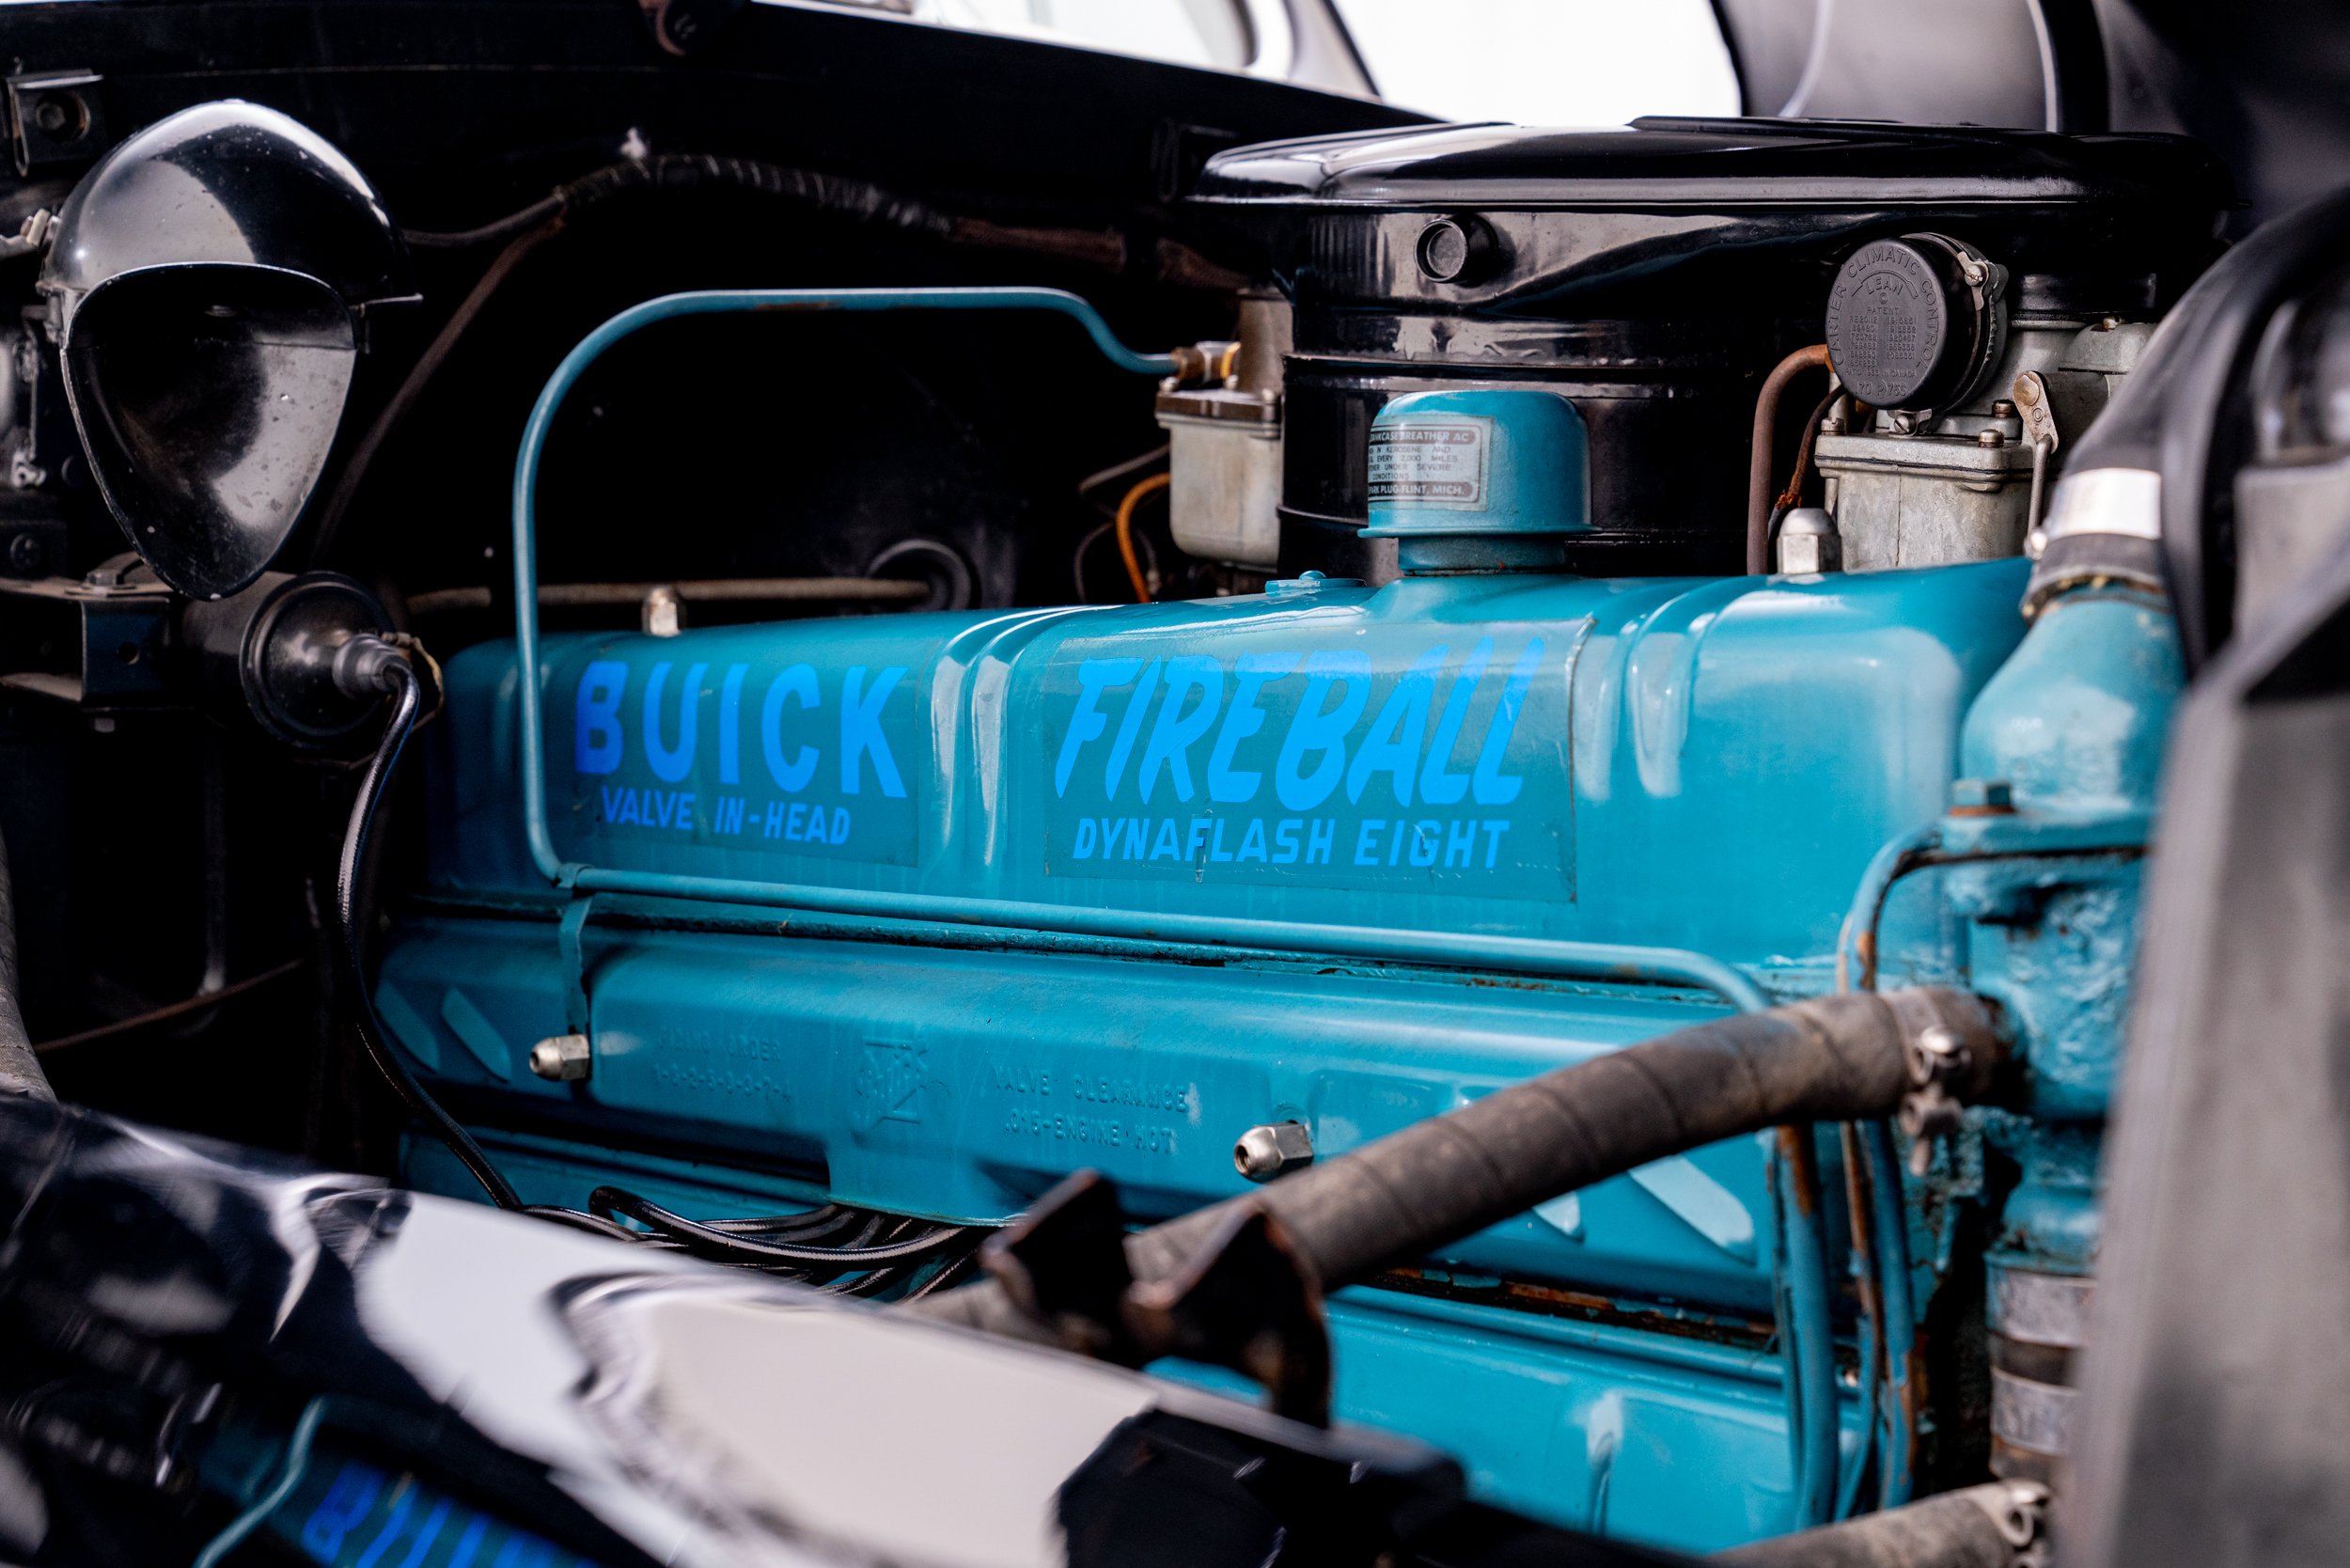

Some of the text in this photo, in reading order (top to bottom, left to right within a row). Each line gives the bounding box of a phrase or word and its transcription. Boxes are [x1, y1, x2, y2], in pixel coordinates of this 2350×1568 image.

[1865, 276, 1904, 295] LEAN
[1828, 246, 1939, 368] CARTER CLIMATIC CONTROL
[1867, 306, 1900, 315] PATENT
[1891, 369, 1917, 378] CANADA
[1399, 431, 1449, 441] BREATHER
[1453, 432, 1469, 441] AC
[1433, 485, 1465, 494] MICH.
[575, 661, 911, 799] BUICK
[1055, 635, 1545, 812] FIREBALL
[602, 784, 852, 845] VALVE IN-HEAD
[1073, 818, 1510, 869] DYNAFLASH EIGHT
[729, 1034, 781, 1063] ORDER
[993, 1065, 1189, 1113] VALVE CLEARANCE
[1136, 1123, 1172, 1155] HOT
